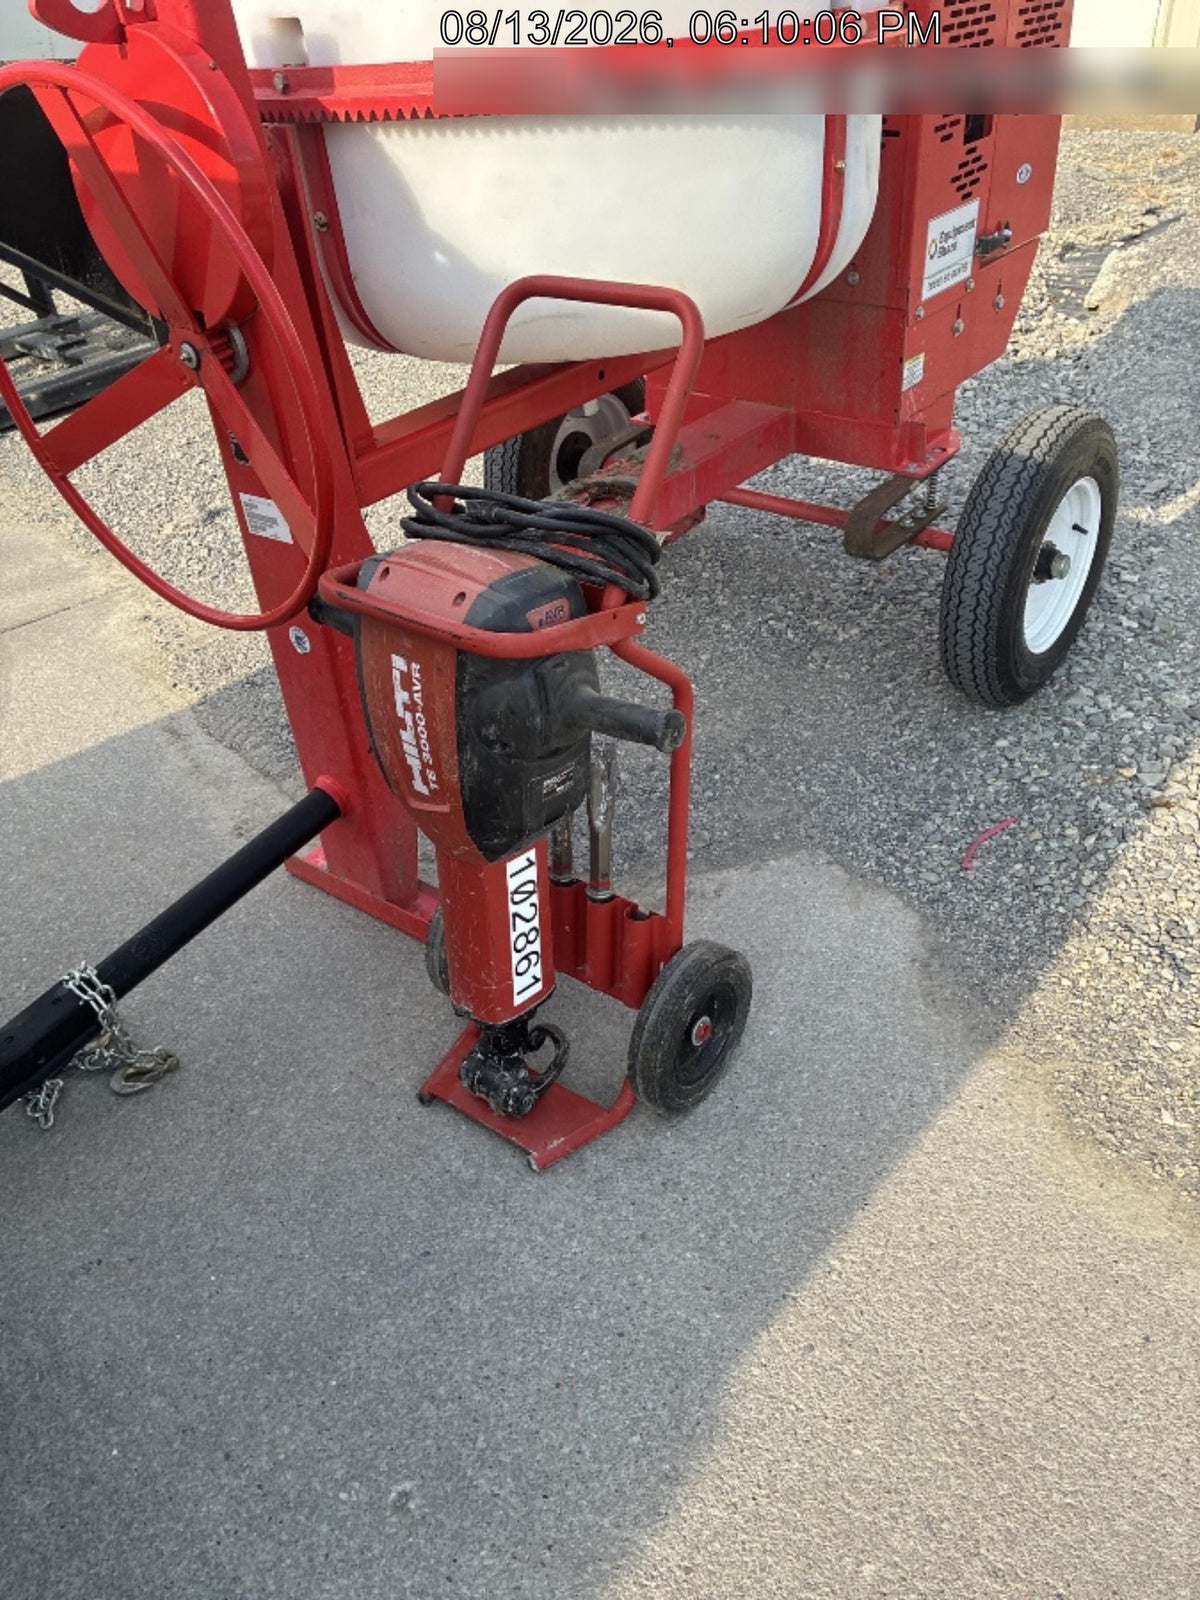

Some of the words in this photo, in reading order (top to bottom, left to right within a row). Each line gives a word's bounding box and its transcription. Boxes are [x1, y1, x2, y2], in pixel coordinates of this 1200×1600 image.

[391, 653, 430, 796] HILTI
[411, 661, 433, 765] 3000-AVR
[426, 767, 439, 790] TE
[509, 856, 541, 997] 102861
